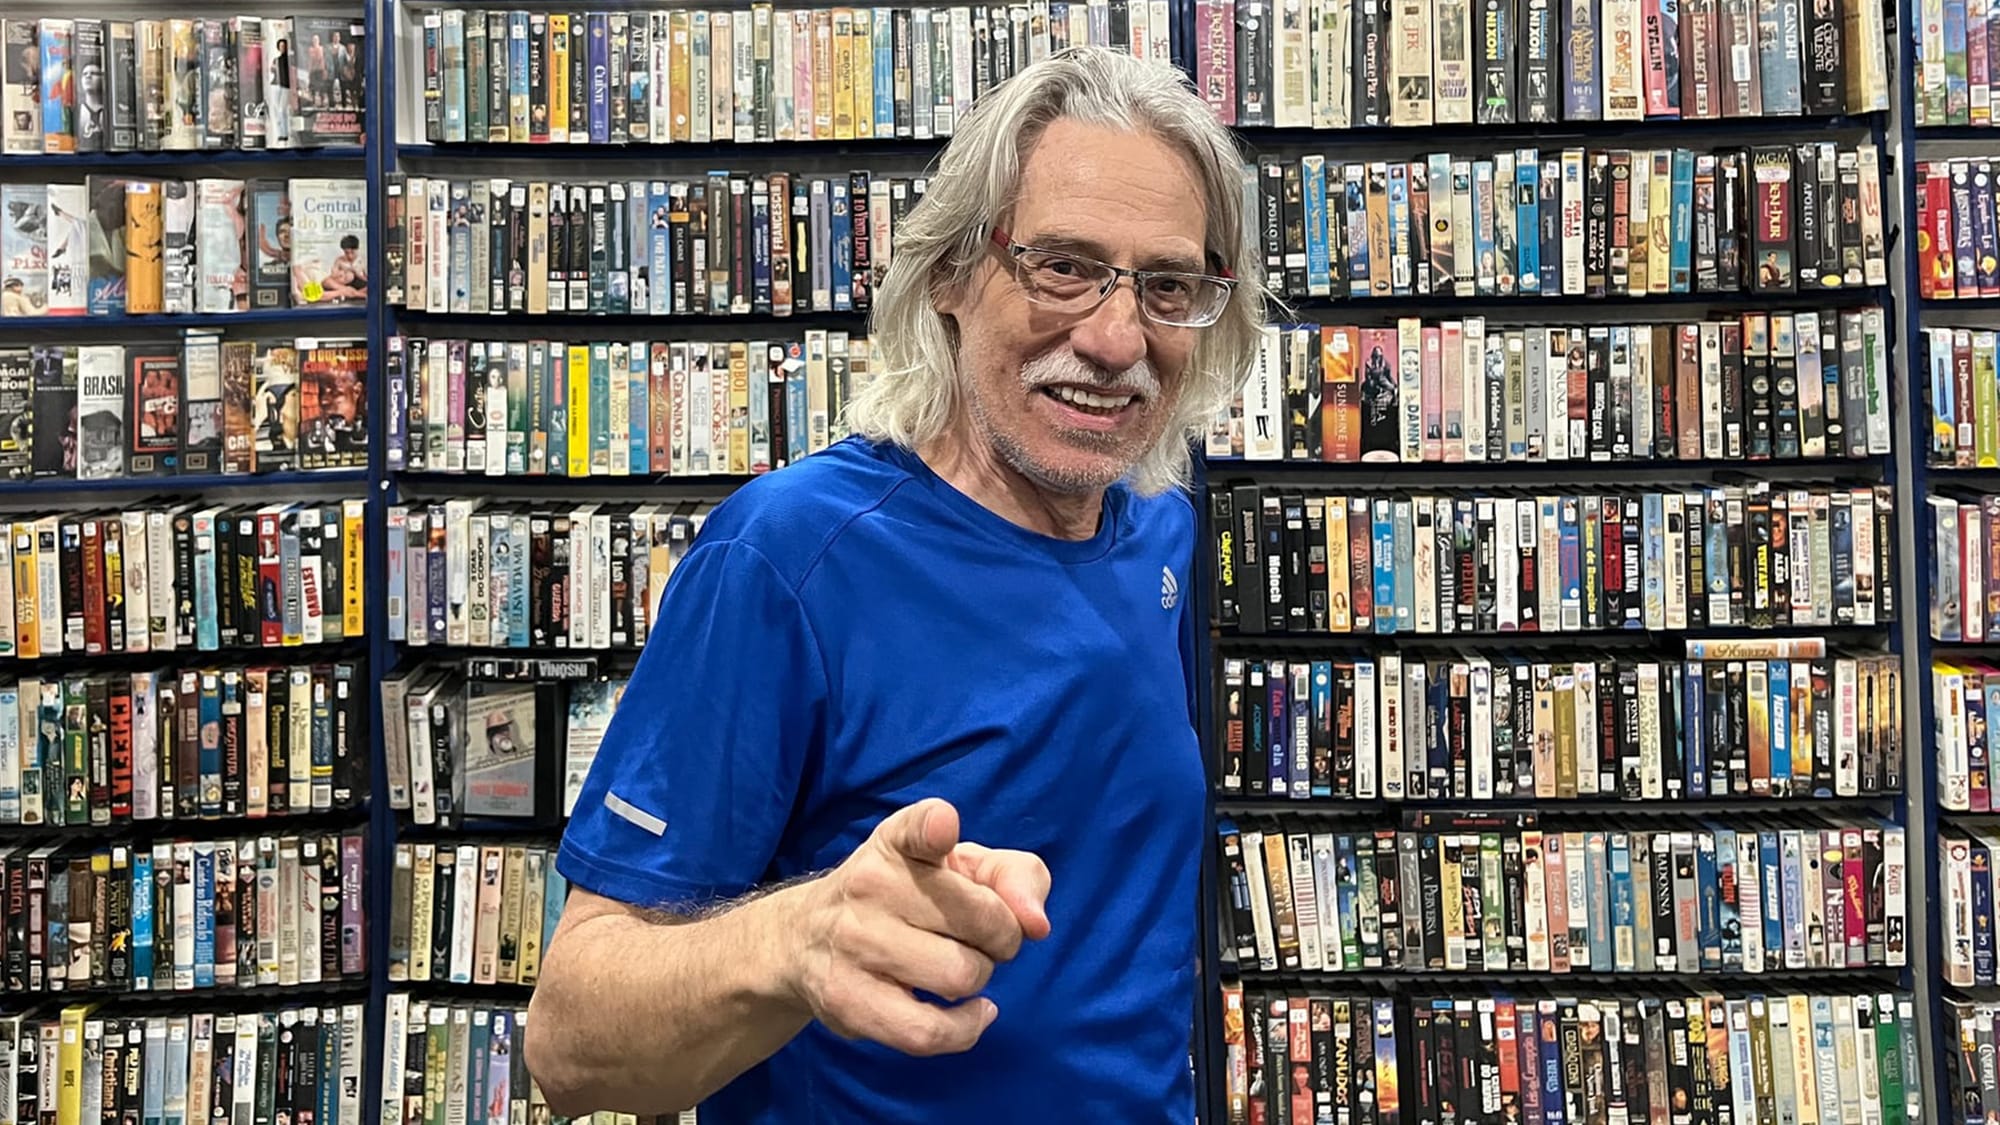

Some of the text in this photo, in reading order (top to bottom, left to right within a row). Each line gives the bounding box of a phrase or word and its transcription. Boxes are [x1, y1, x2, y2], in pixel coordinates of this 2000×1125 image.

[1366, 33, 1377, 67] Guerra
[1406, 27, 1419, 49] JFK
[1486, 11, 1497, 60] NIXON
[1529, 10, 1539, 59] NIXON
[1647, 15, 1662, 71] STALIN
[1693, 16, 1707, 81] HAMLET
[1784, 3, 1797, 59] GANDHI
[1814, 25, 1824, 72] VALENTE
[1823, 22, 1835, 72] CORAÇÃO
[1366, 78, 1377, 98] Paz
[1754, 152, 1790, 162] MGM
[304, 198, 362, 213] Central
[1267, 195, 1277, 238] APOLLO
[1573, 200, 1582, 222] FUGA
[1804, 182, 1813, 226] APOLLO
[1954, 188, 1972, 248] ARISTOGATAS
[1977, 194, 1990, 223] Espada
[1588, 219, 1596, 271] A PESTE
[1598, 221, 1606, 269] CAMUS
[1512, 355, 1520, 369] THE
[1260, 376, 1268, 409] LYNDON
[1336, 383, 1347, 441] SUNSHINE
[1556, 370, 1567, 418] NUNCA
[1593, 421, 1602, 439] CASA
[348, 563, 357, 592] Anima
[513, 565, 523, 591] VIDA
[1269, 555, 1282, 603] Moloch
[1586, 550, 1596, 564] de
[1624, 544, 1638, 592] LANTANA
[302, 566, 321, 617] ESTORVO
[540, 662, 588, 677] INSÔNIA
[1273, 689, 1284, 717] falo
[1524, 690, 1531, 700] 12
[1630, 698, 1639, 742] PONETTE
[1273, 744, 1284, 766] ela
[1295, 716, 1308, 770] maldade
[1424, 885, 1439, 936] PERVERSA
[103, 1049, 118, 1119] Christiane F.
[1978, 1044, 1996, 1090] CINDERELA
